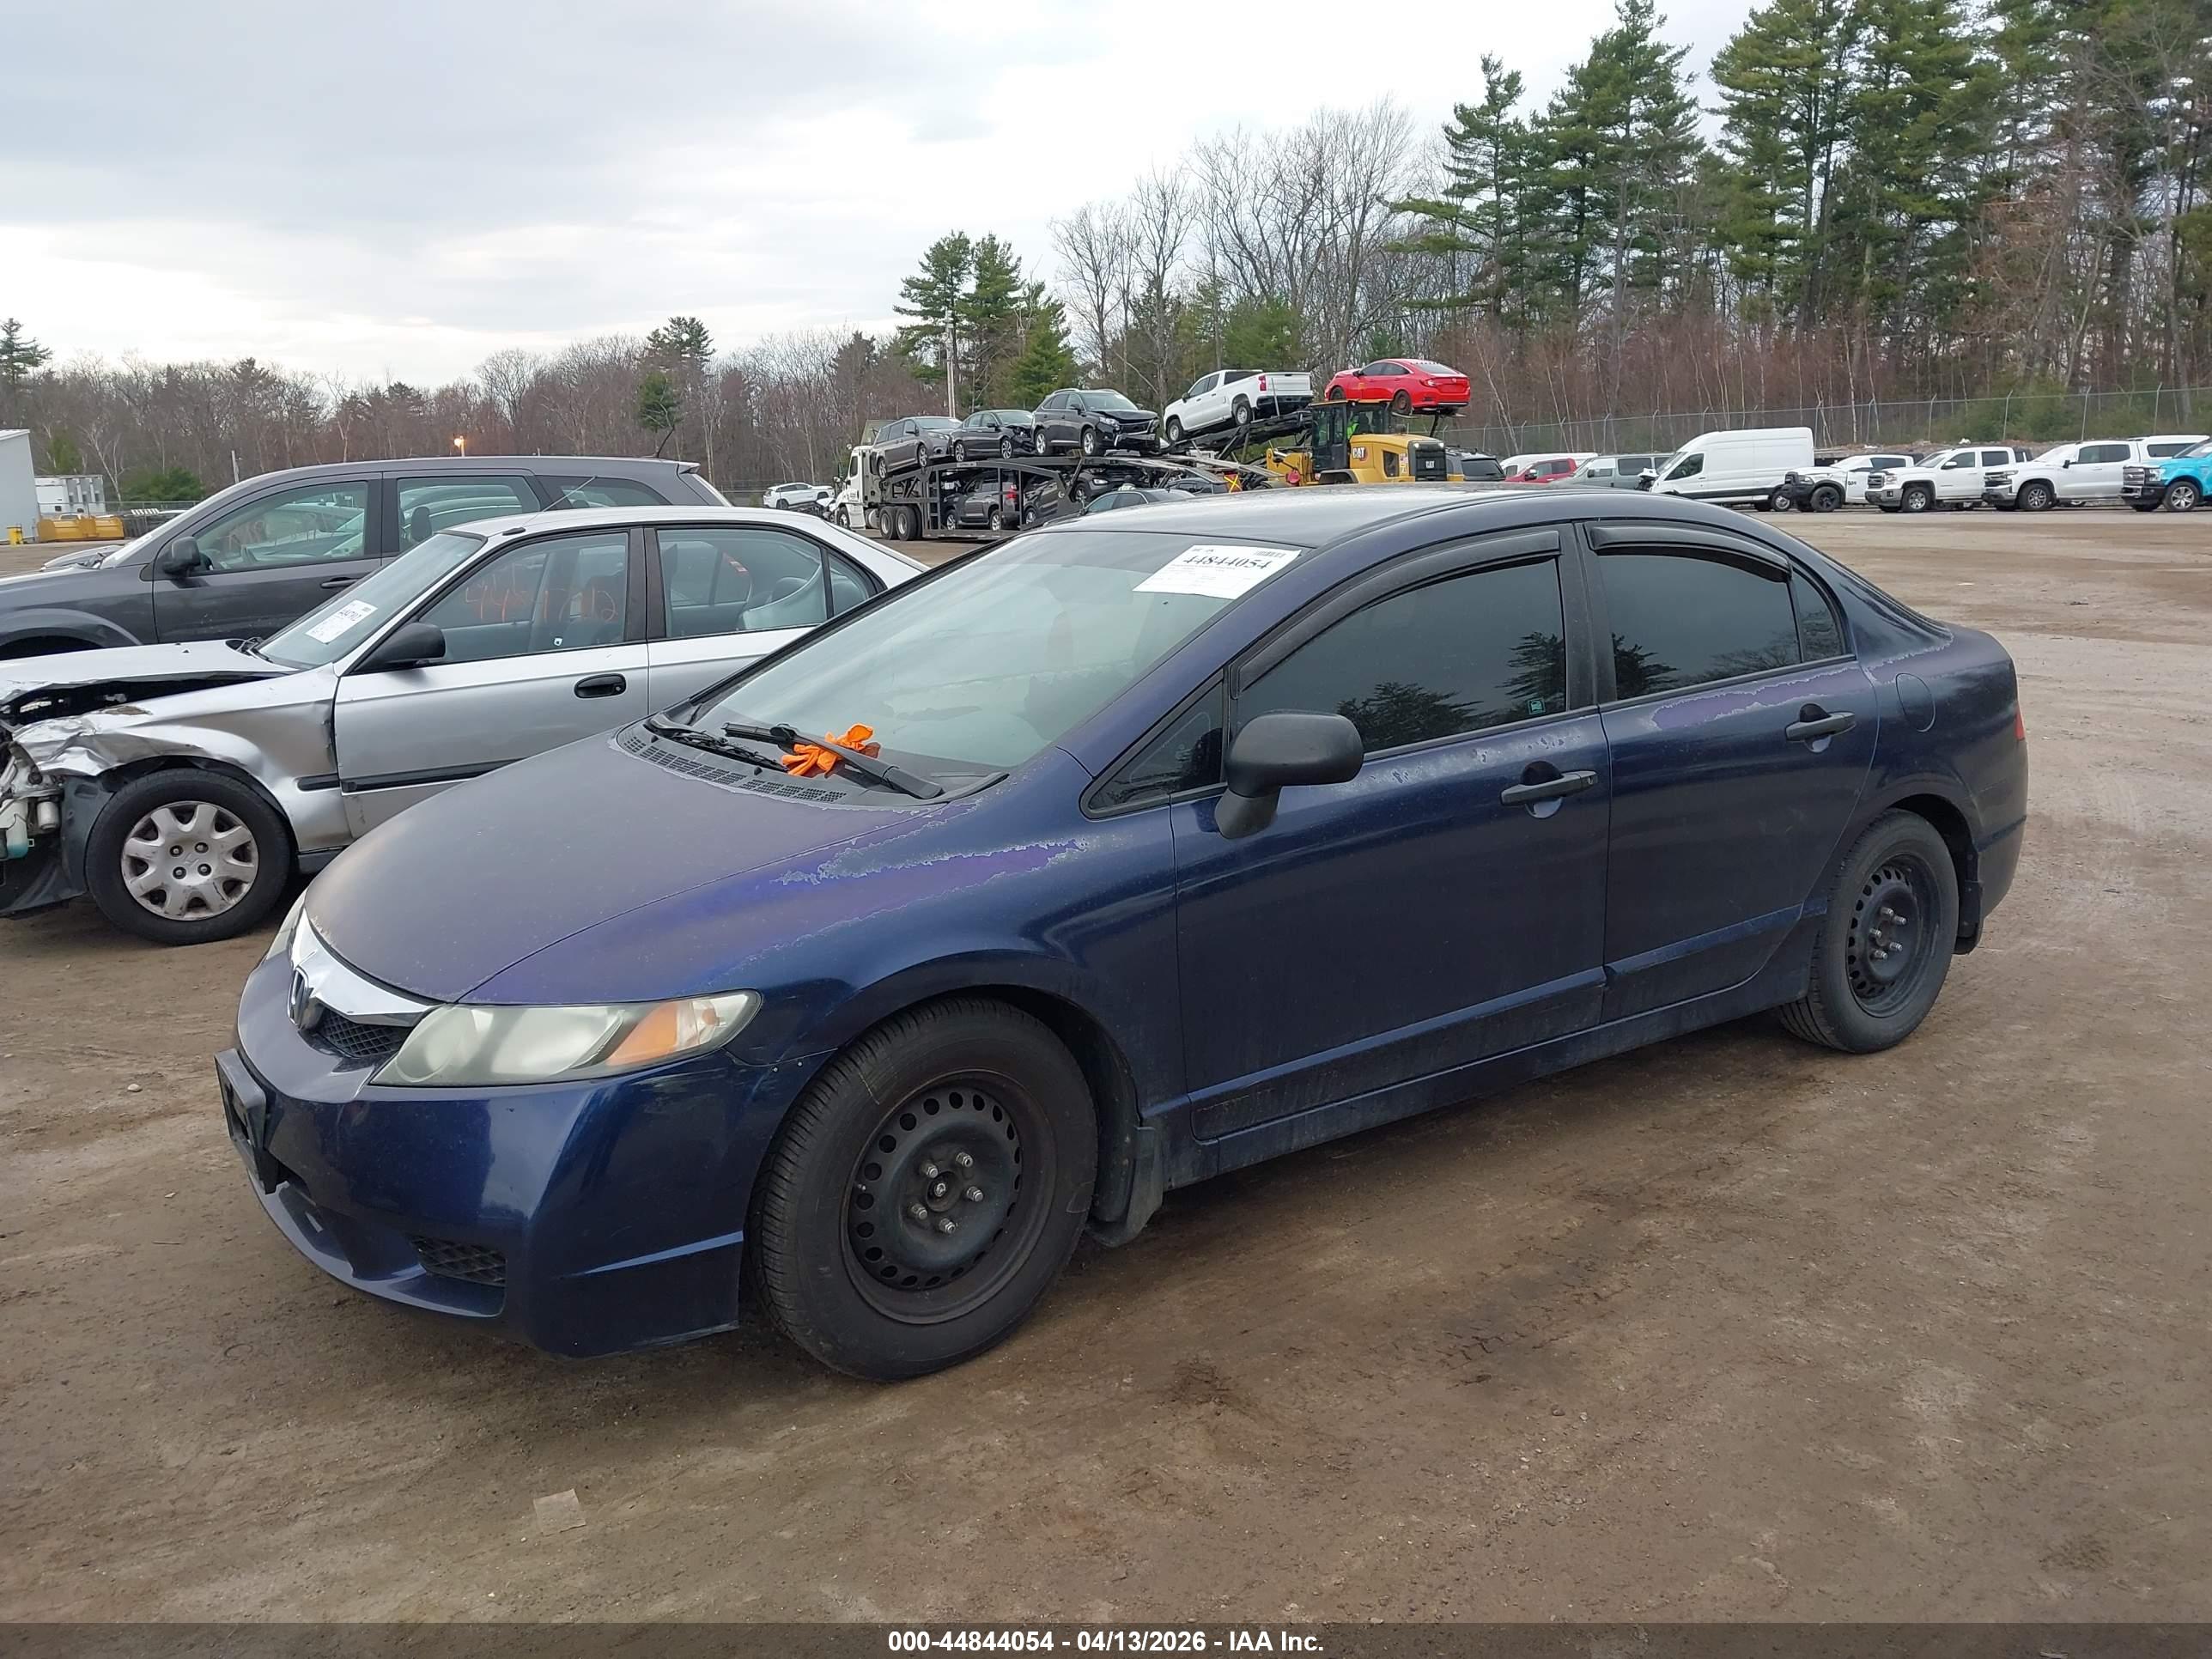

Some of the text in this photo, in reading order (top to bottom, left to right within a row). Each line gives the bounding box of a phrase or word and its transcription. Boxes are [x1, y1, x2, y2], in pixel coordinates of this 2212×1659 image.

[1352, 447, 1365, 459] CAT
[1425, 460, 1435, 469] CAT
[1182, 555, 1273, 569] 44844054
